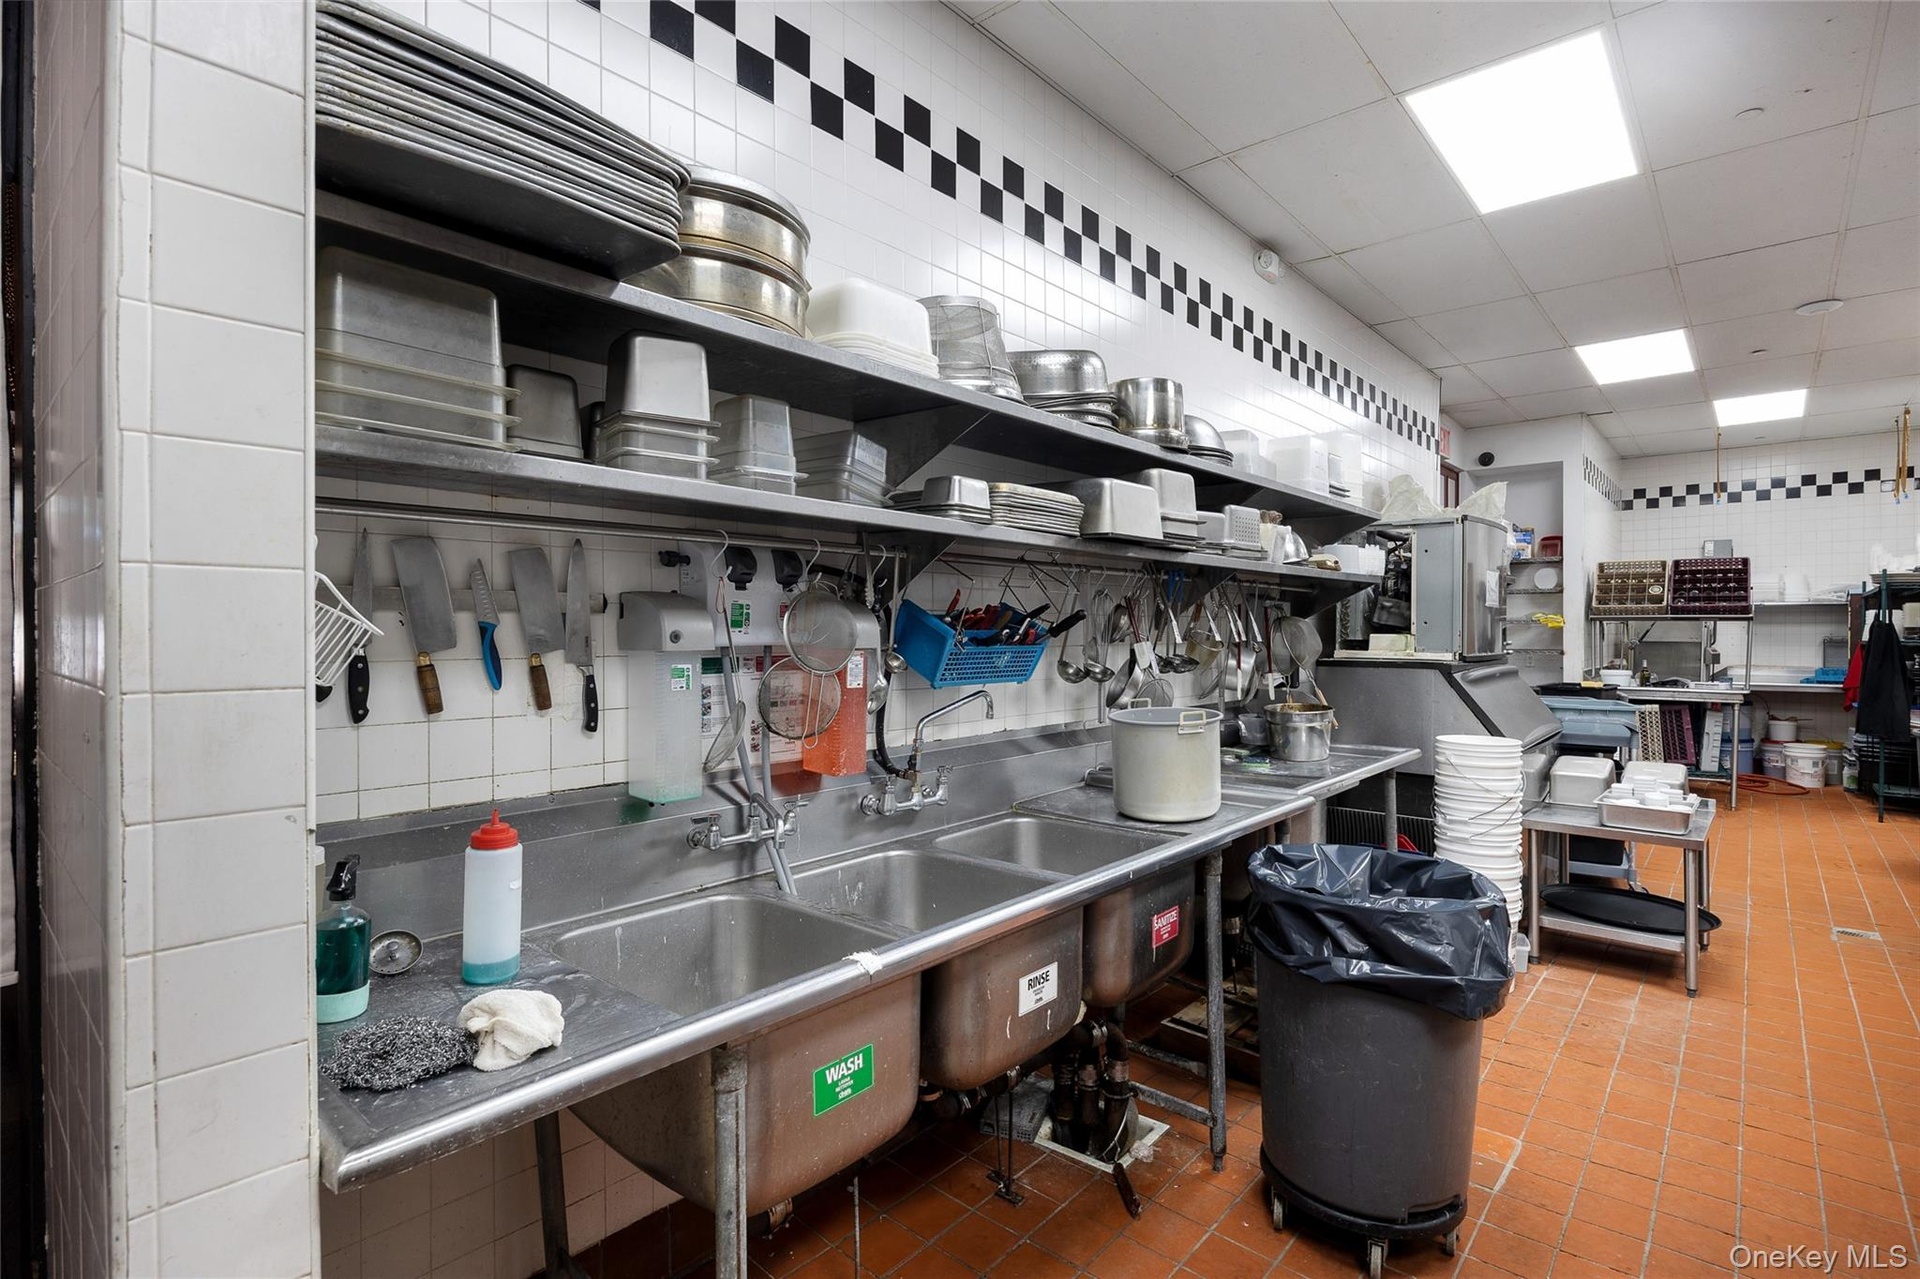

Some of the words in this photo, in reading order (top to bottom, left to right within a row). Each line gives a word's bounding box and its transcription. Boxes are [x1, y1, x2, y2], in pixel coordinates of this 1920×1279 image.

[1154, 909, 1178, 930] SANITIZE
[1027, 970, 1050, 991] RINSE
[825, 1053, 863, 1085] WASH
